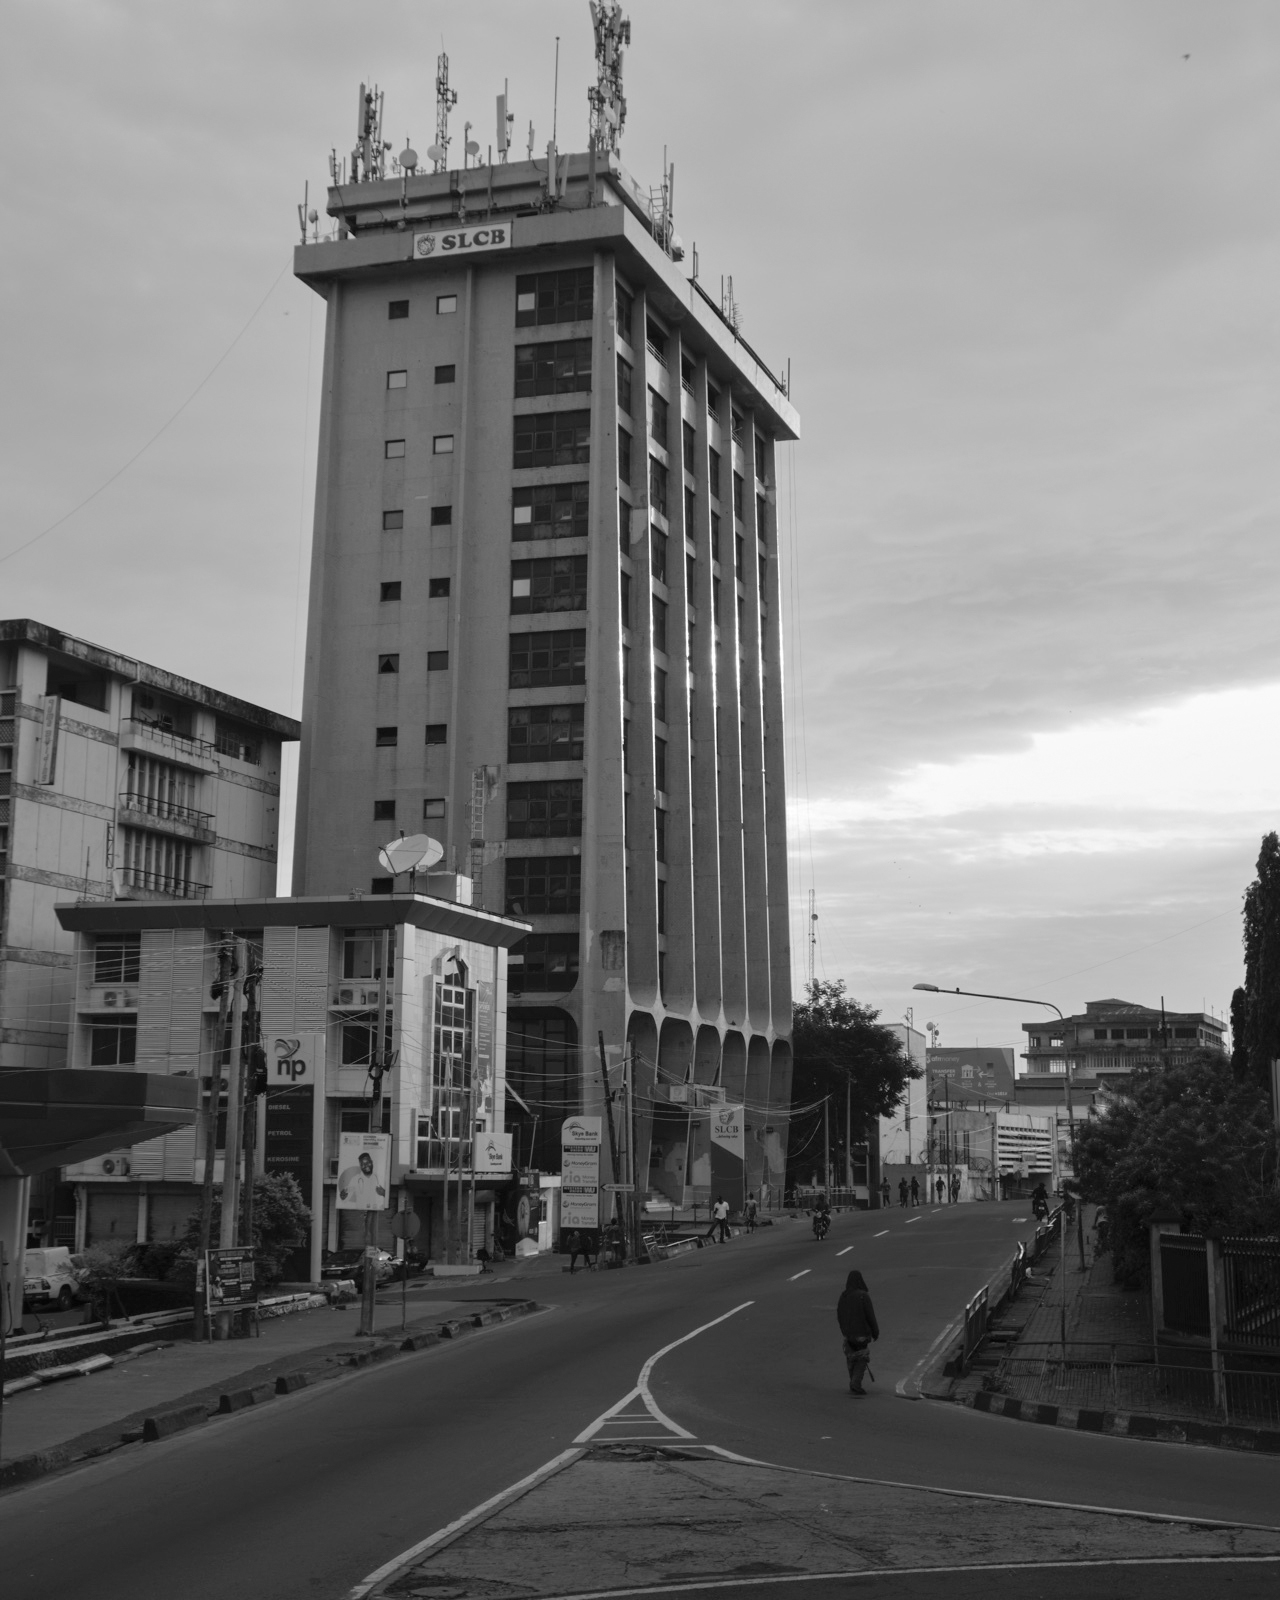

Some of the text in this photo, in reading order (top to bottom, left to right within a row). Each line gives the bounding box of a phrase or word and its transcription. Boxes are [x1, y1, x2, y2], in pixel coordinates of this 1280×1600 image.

[441, 229, 505, 251] SLCB
[277, 1059, 306, 1081] np
[714, 1125, 739, 1134] SLCB
[563, 1170, 581, 1183] ria
[562, 1211, 580, 1225] ria
